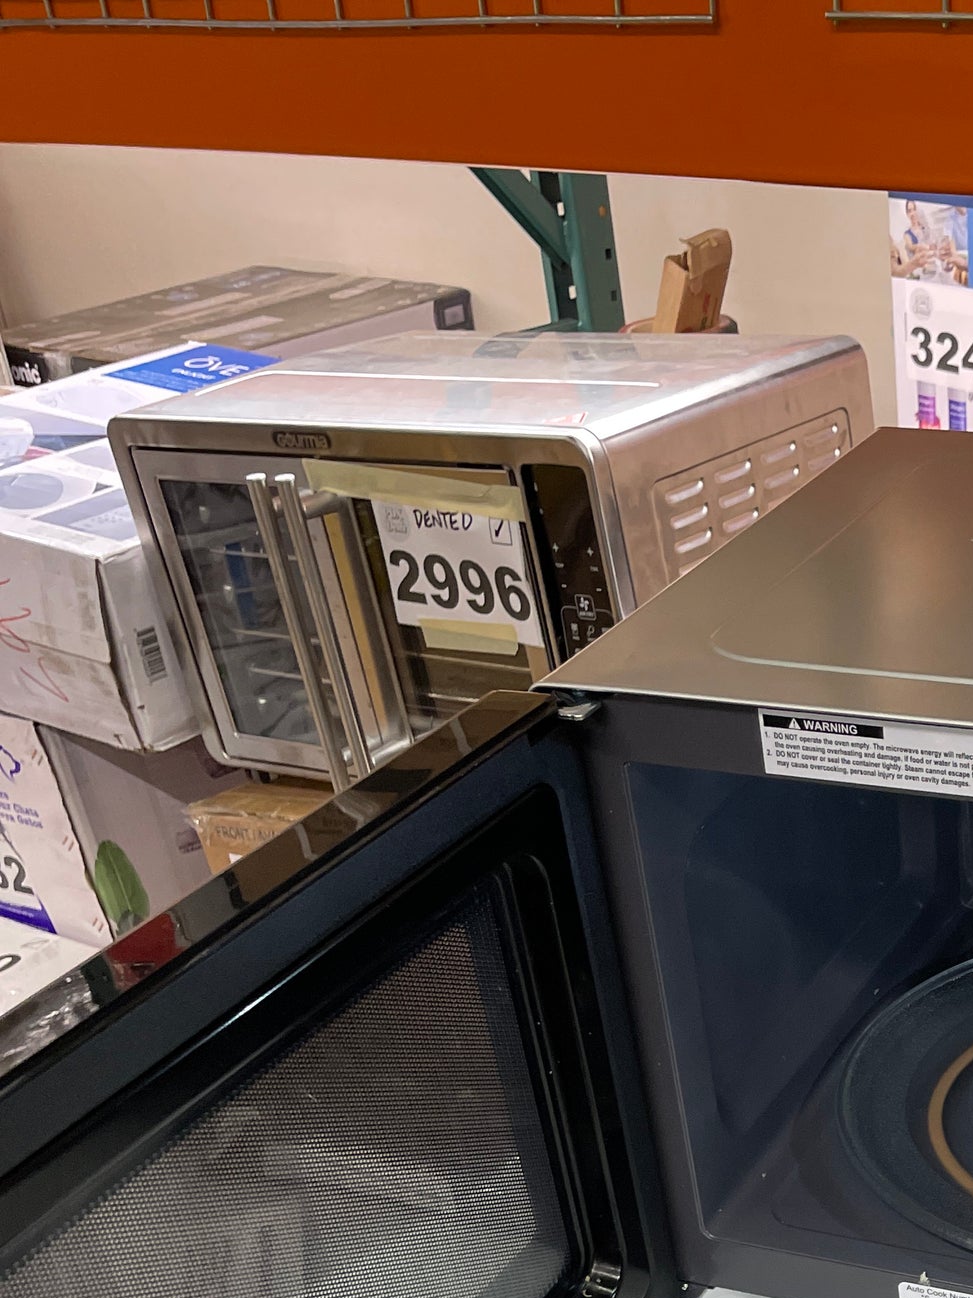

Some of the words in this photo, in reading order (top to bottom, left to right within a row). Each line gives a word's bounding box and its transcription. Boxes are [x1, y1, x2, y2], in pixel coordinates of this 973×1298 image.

[413, 509, 473, 531] DENTED
[389, 550, 531, 621] 2996
[803, 720, 859, 736] WARNING
[906, 1285, 925, 1294] Auto
[927, 1287, 947, 1298] Cook
